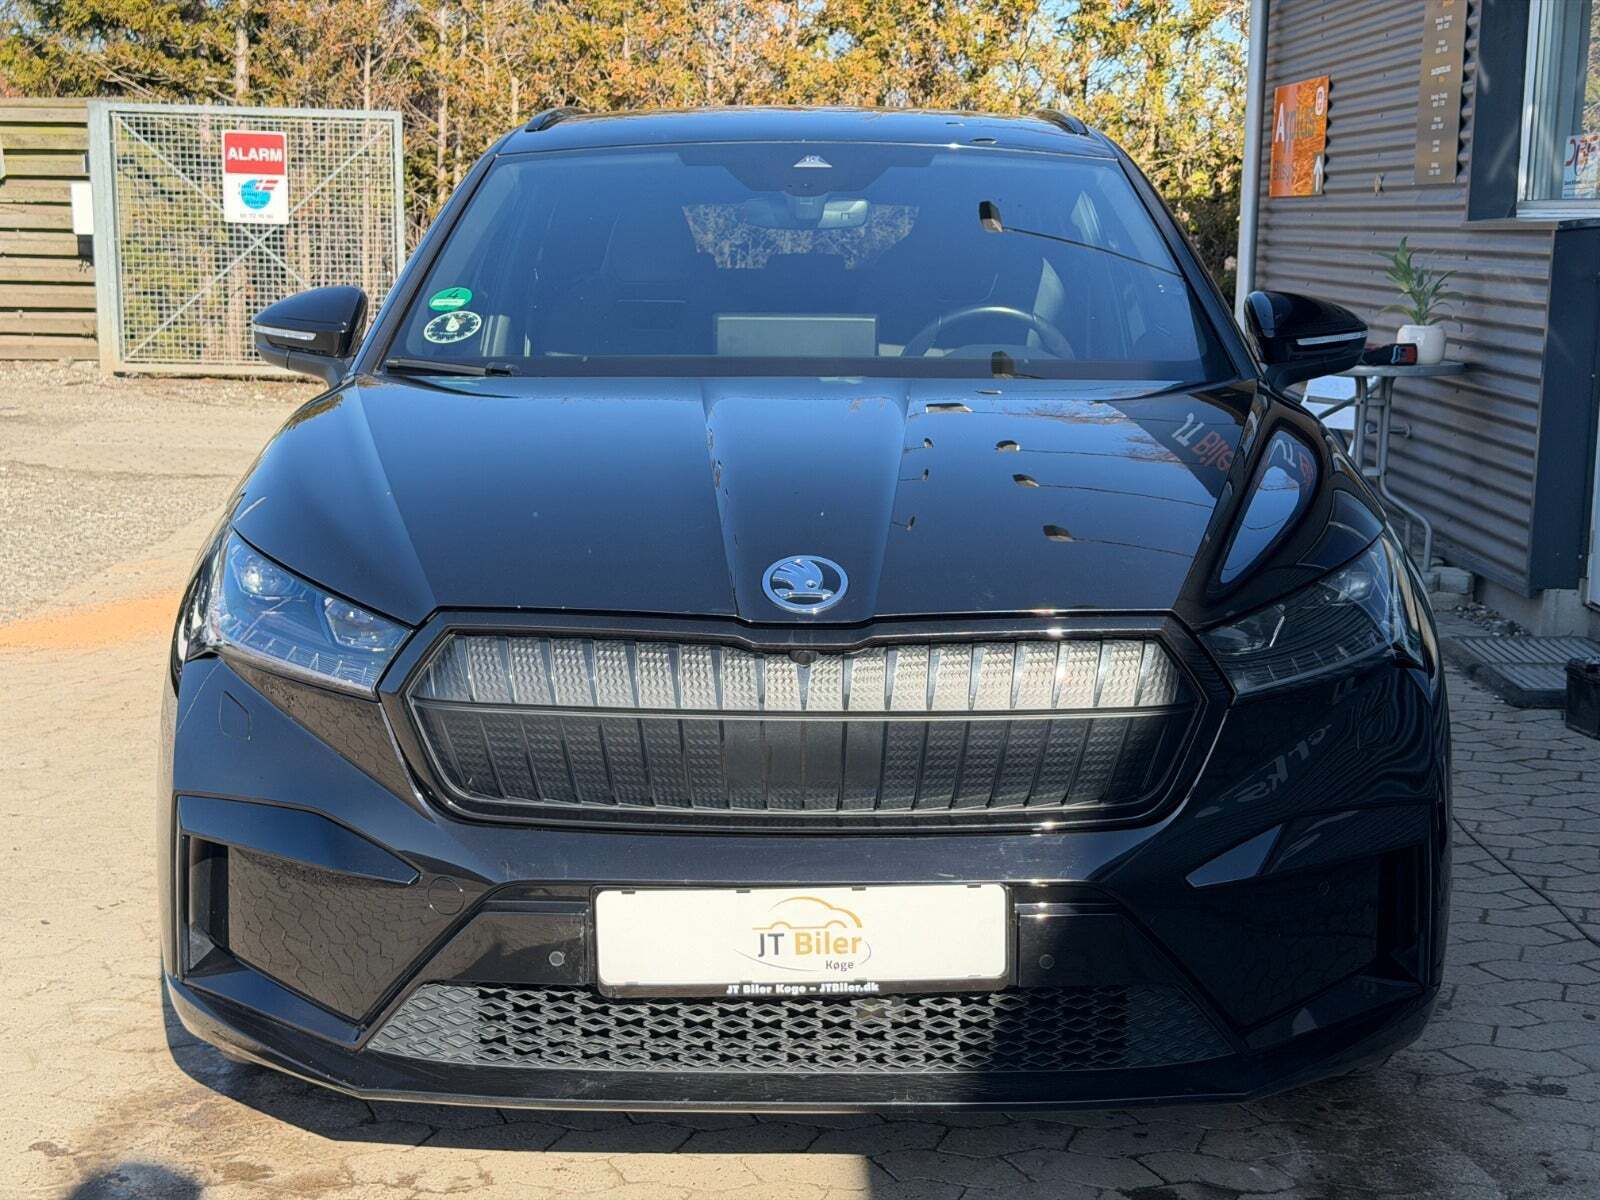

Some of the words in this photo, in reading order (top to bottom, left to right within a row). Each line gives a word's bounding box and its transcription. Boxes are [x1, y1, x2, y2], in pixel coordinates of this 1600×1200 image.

[228, 146, 284, 162] ALARM
[758, 932, 784, 958] JT
[794, 929, 862, 956] Biler
[825, 959, 855, 972] Køge
[726, 984, 740, 994] JT
[743, 984, 773, 994] Biler
